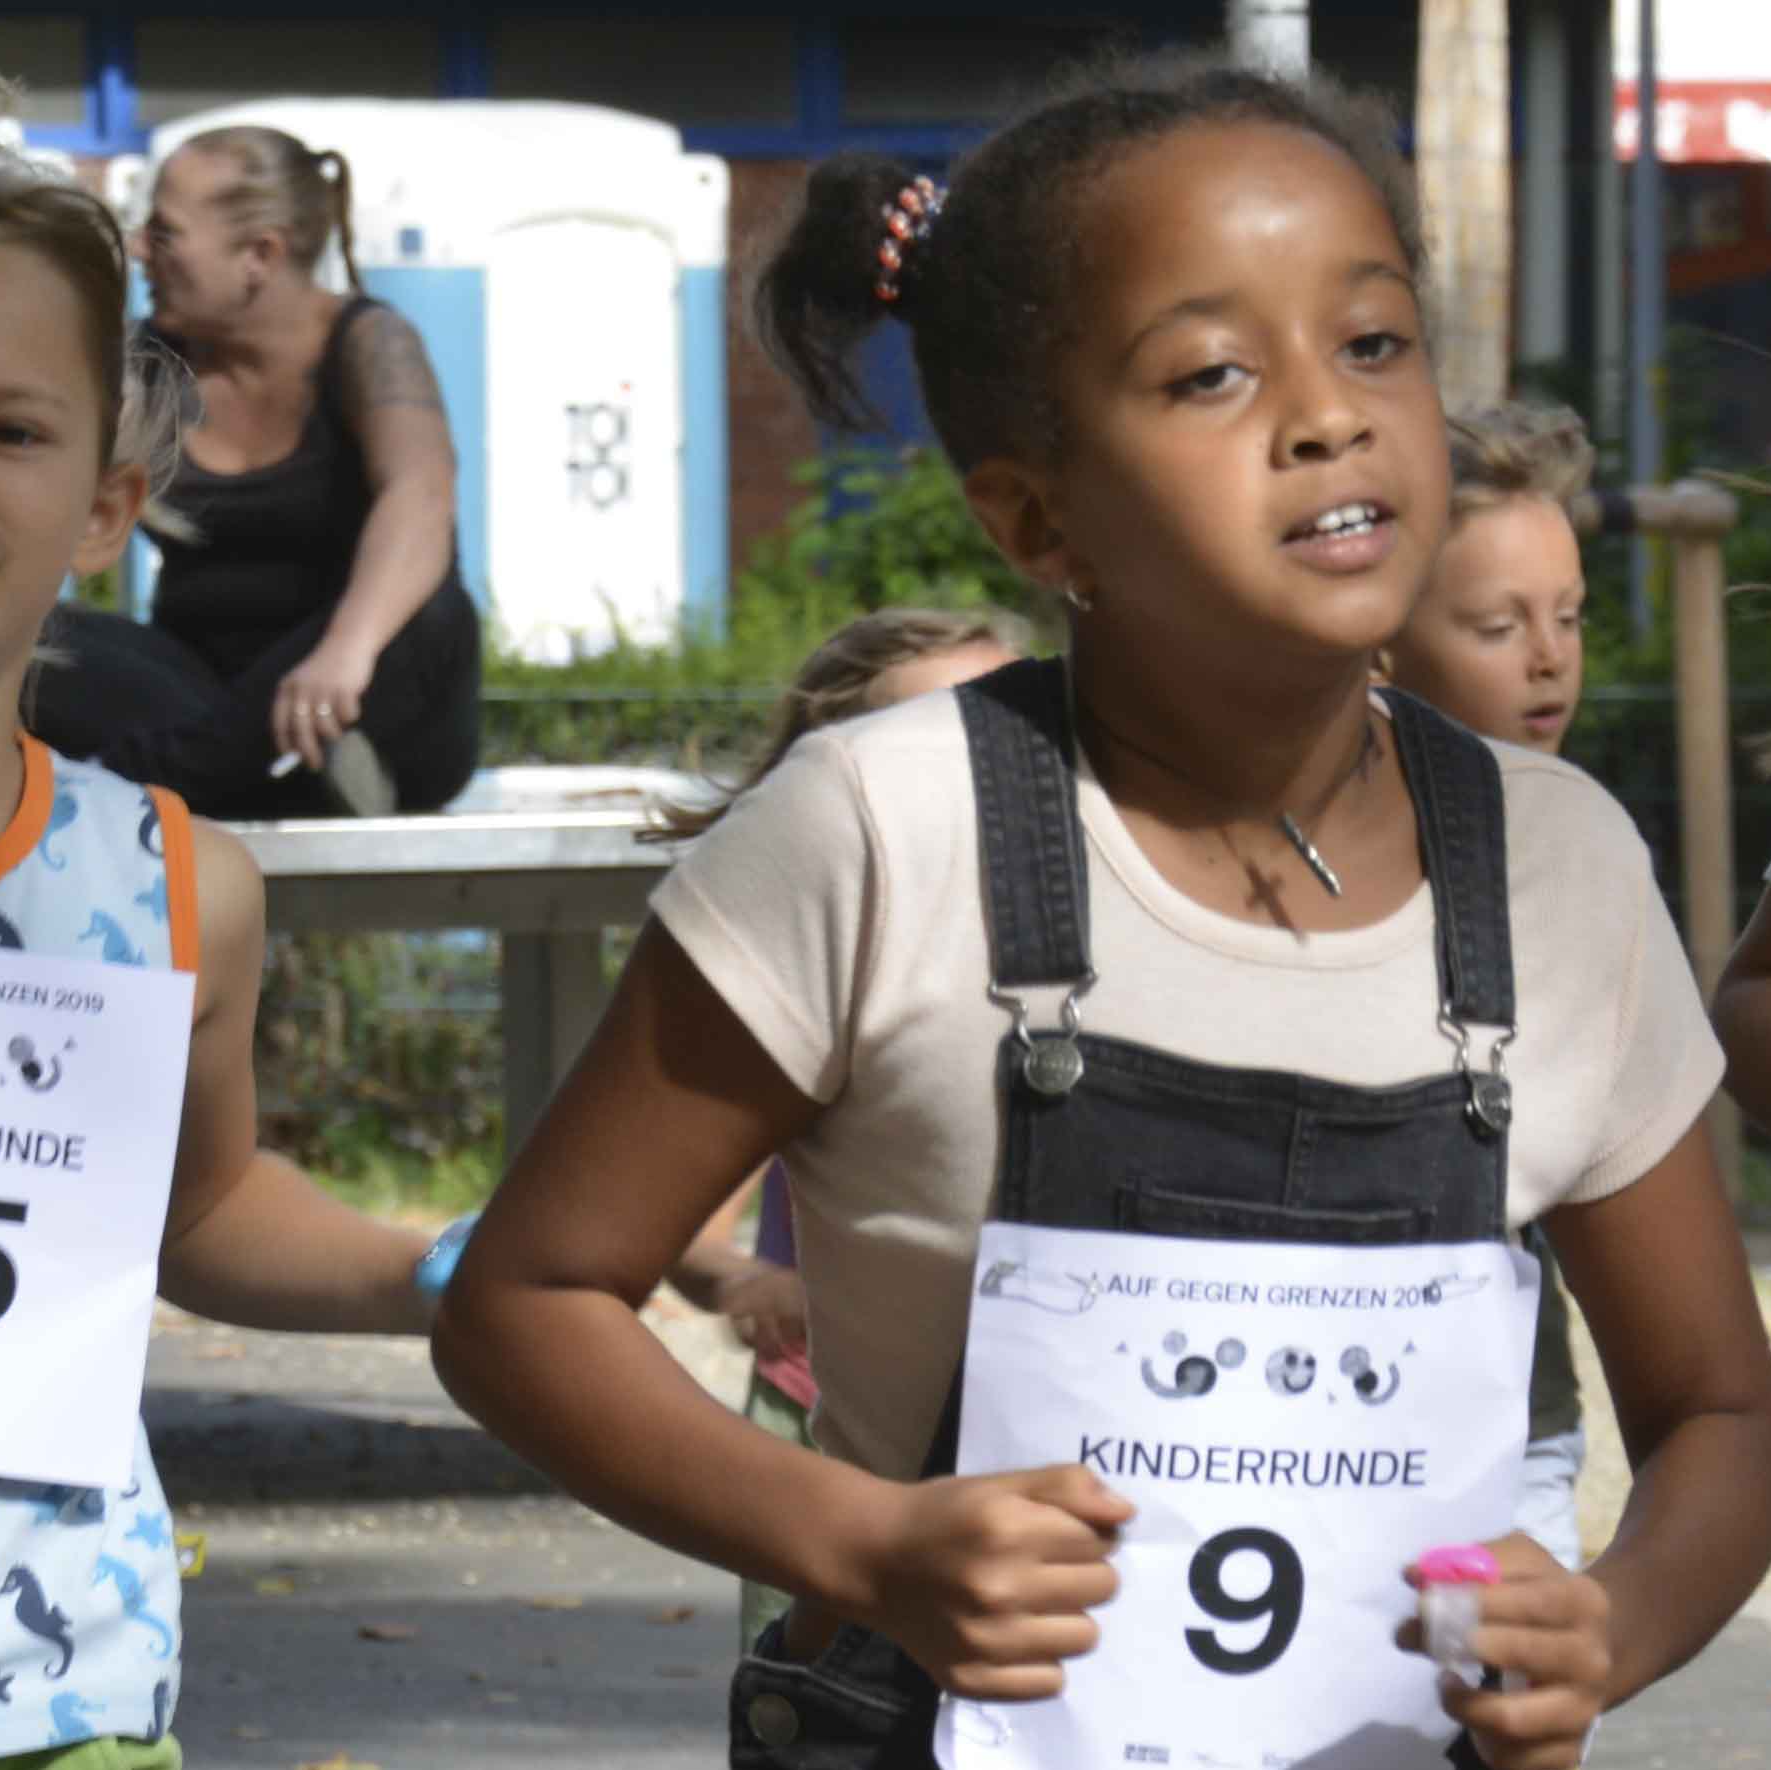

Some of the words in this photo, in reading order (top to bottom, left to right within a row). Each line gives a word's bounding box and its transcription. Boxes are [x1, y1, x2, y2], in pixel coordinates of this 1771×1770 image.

[52, 986, 106, 1014] 2019
[1093, 1273, 1158, 1297] AUF
[1166, 1279, 1259, 1303] GEGEN
[1267, 1284, 1388, 1309] GRENZEN
[1079, 1434, 1428, 1488] KINDERRUNDE
[1183, 1526, 1306, 1677] 9
